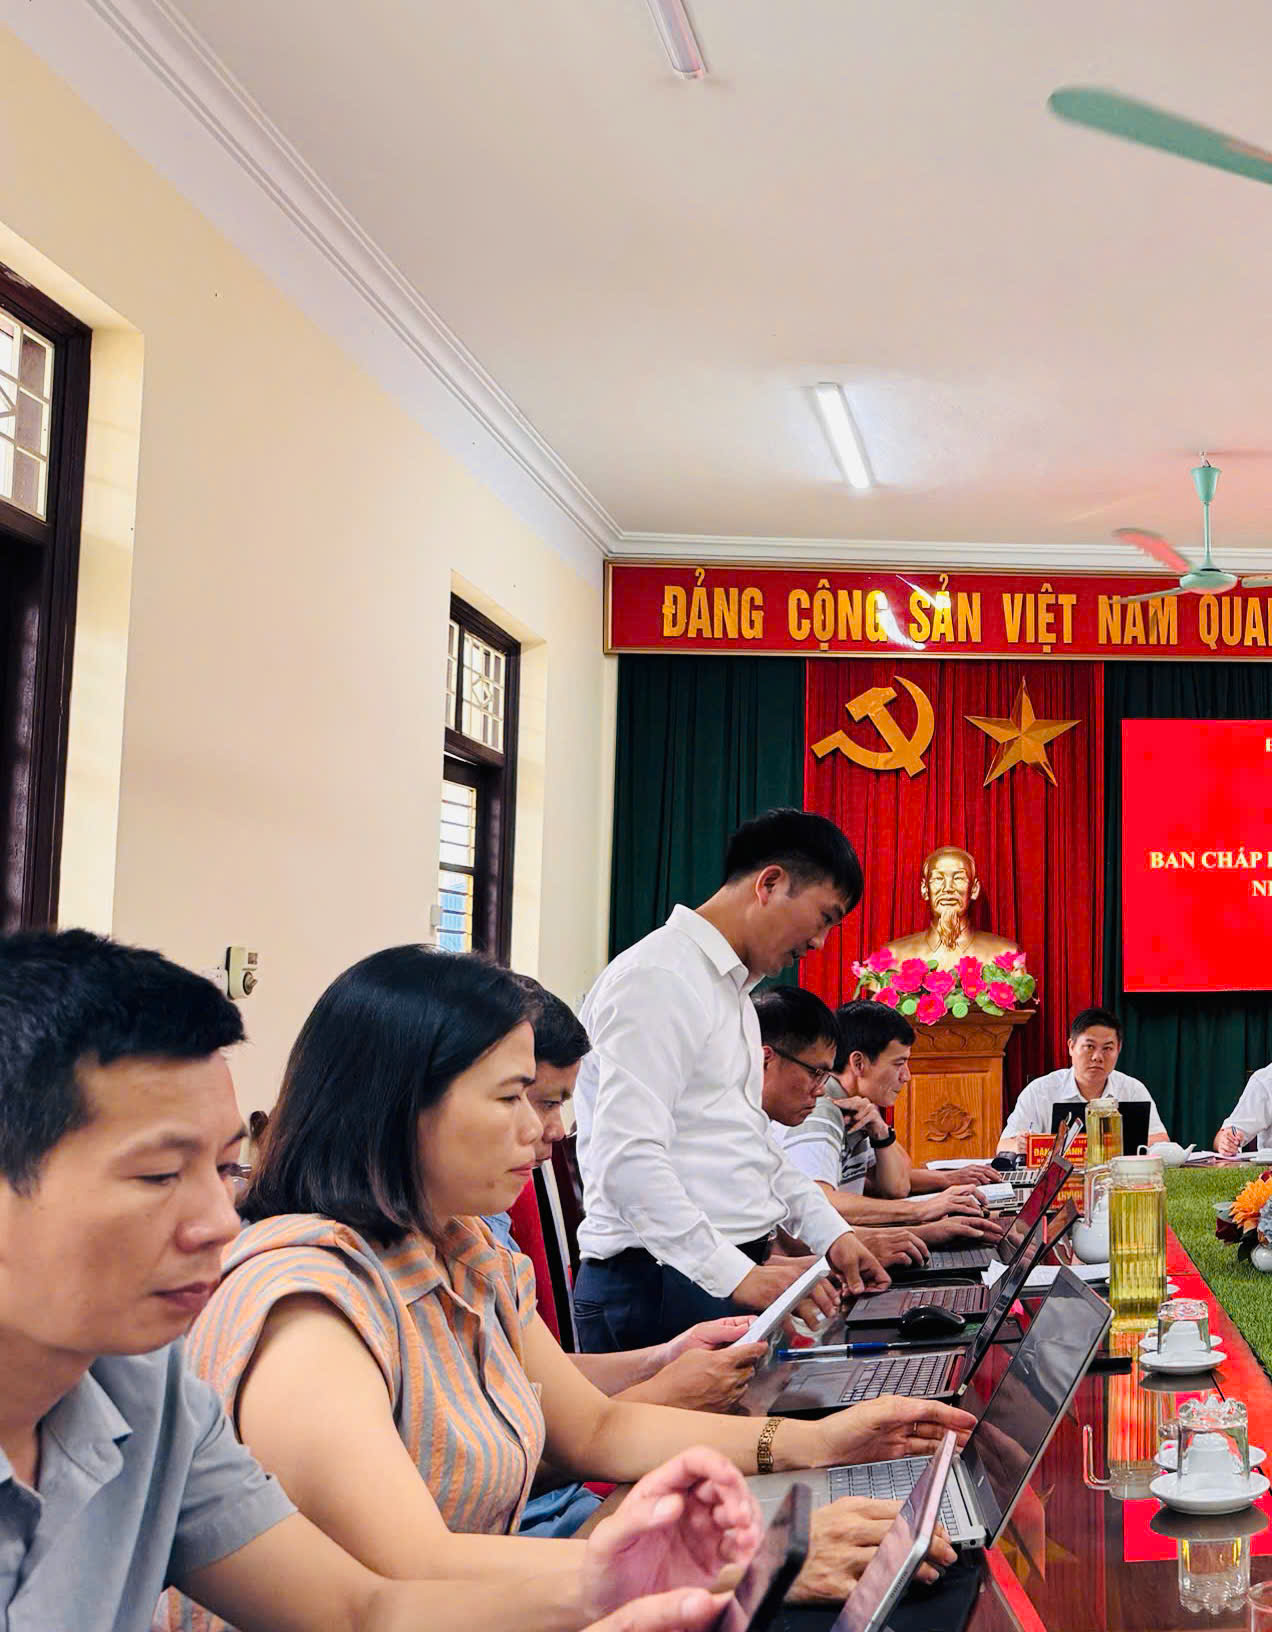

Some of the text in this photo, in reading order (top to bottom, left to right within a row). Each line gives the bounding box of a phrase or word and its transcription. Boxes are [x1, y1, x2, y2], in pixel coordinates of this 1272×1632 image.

[662, 567, 764, 640] ĐẢNG
[787, 578, 887, 651] CỘNG
[908, 573, 982, 644] SẢN
[1002, 583, 1078, 653] VIỆT
[1098, 593, 1178, 646] NAM
[1150, 850, 1195, 869] BAN
